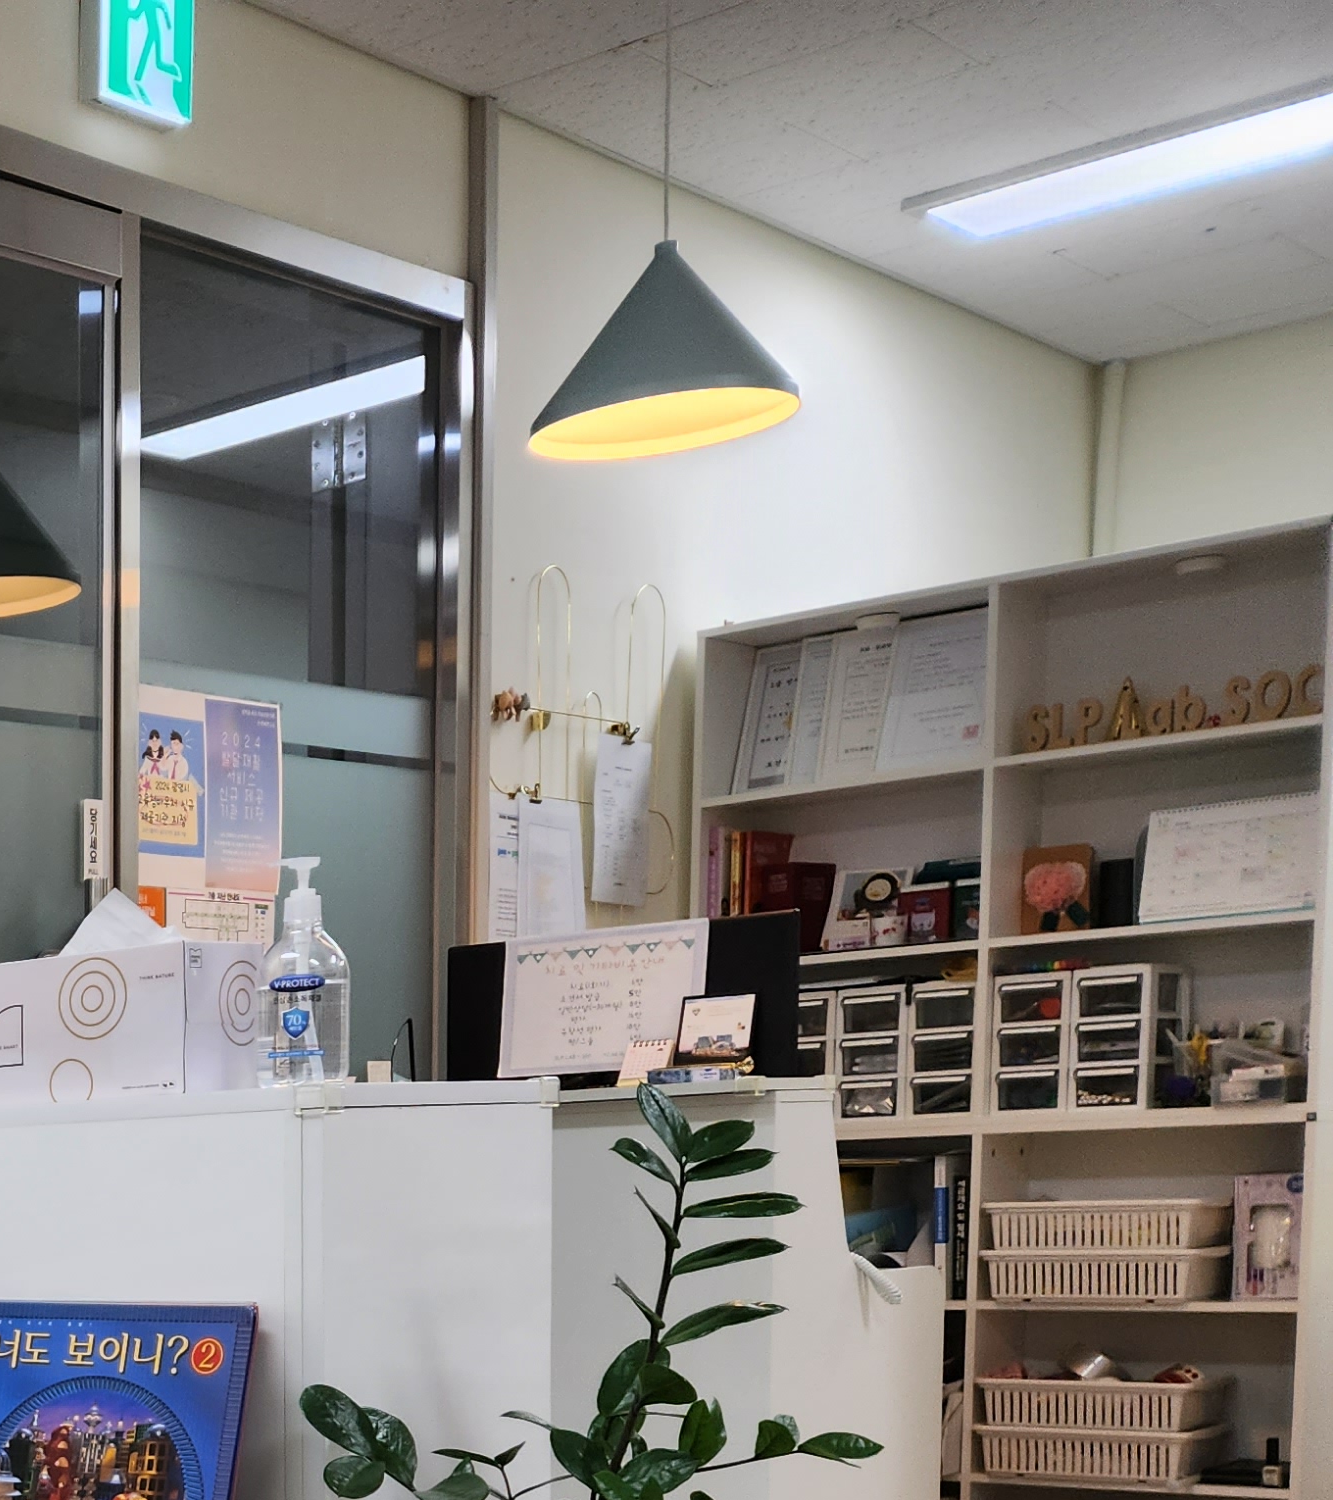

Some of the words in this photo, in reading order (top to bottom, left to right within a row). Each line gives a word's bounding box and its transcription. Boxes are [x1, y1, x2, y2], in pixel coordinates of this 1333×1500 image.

[88, 808, 99, 864] 당기세요
[274, 978, 320, 988] V-PROTECT
[62, 1332, 191, 1375] 보이니?
